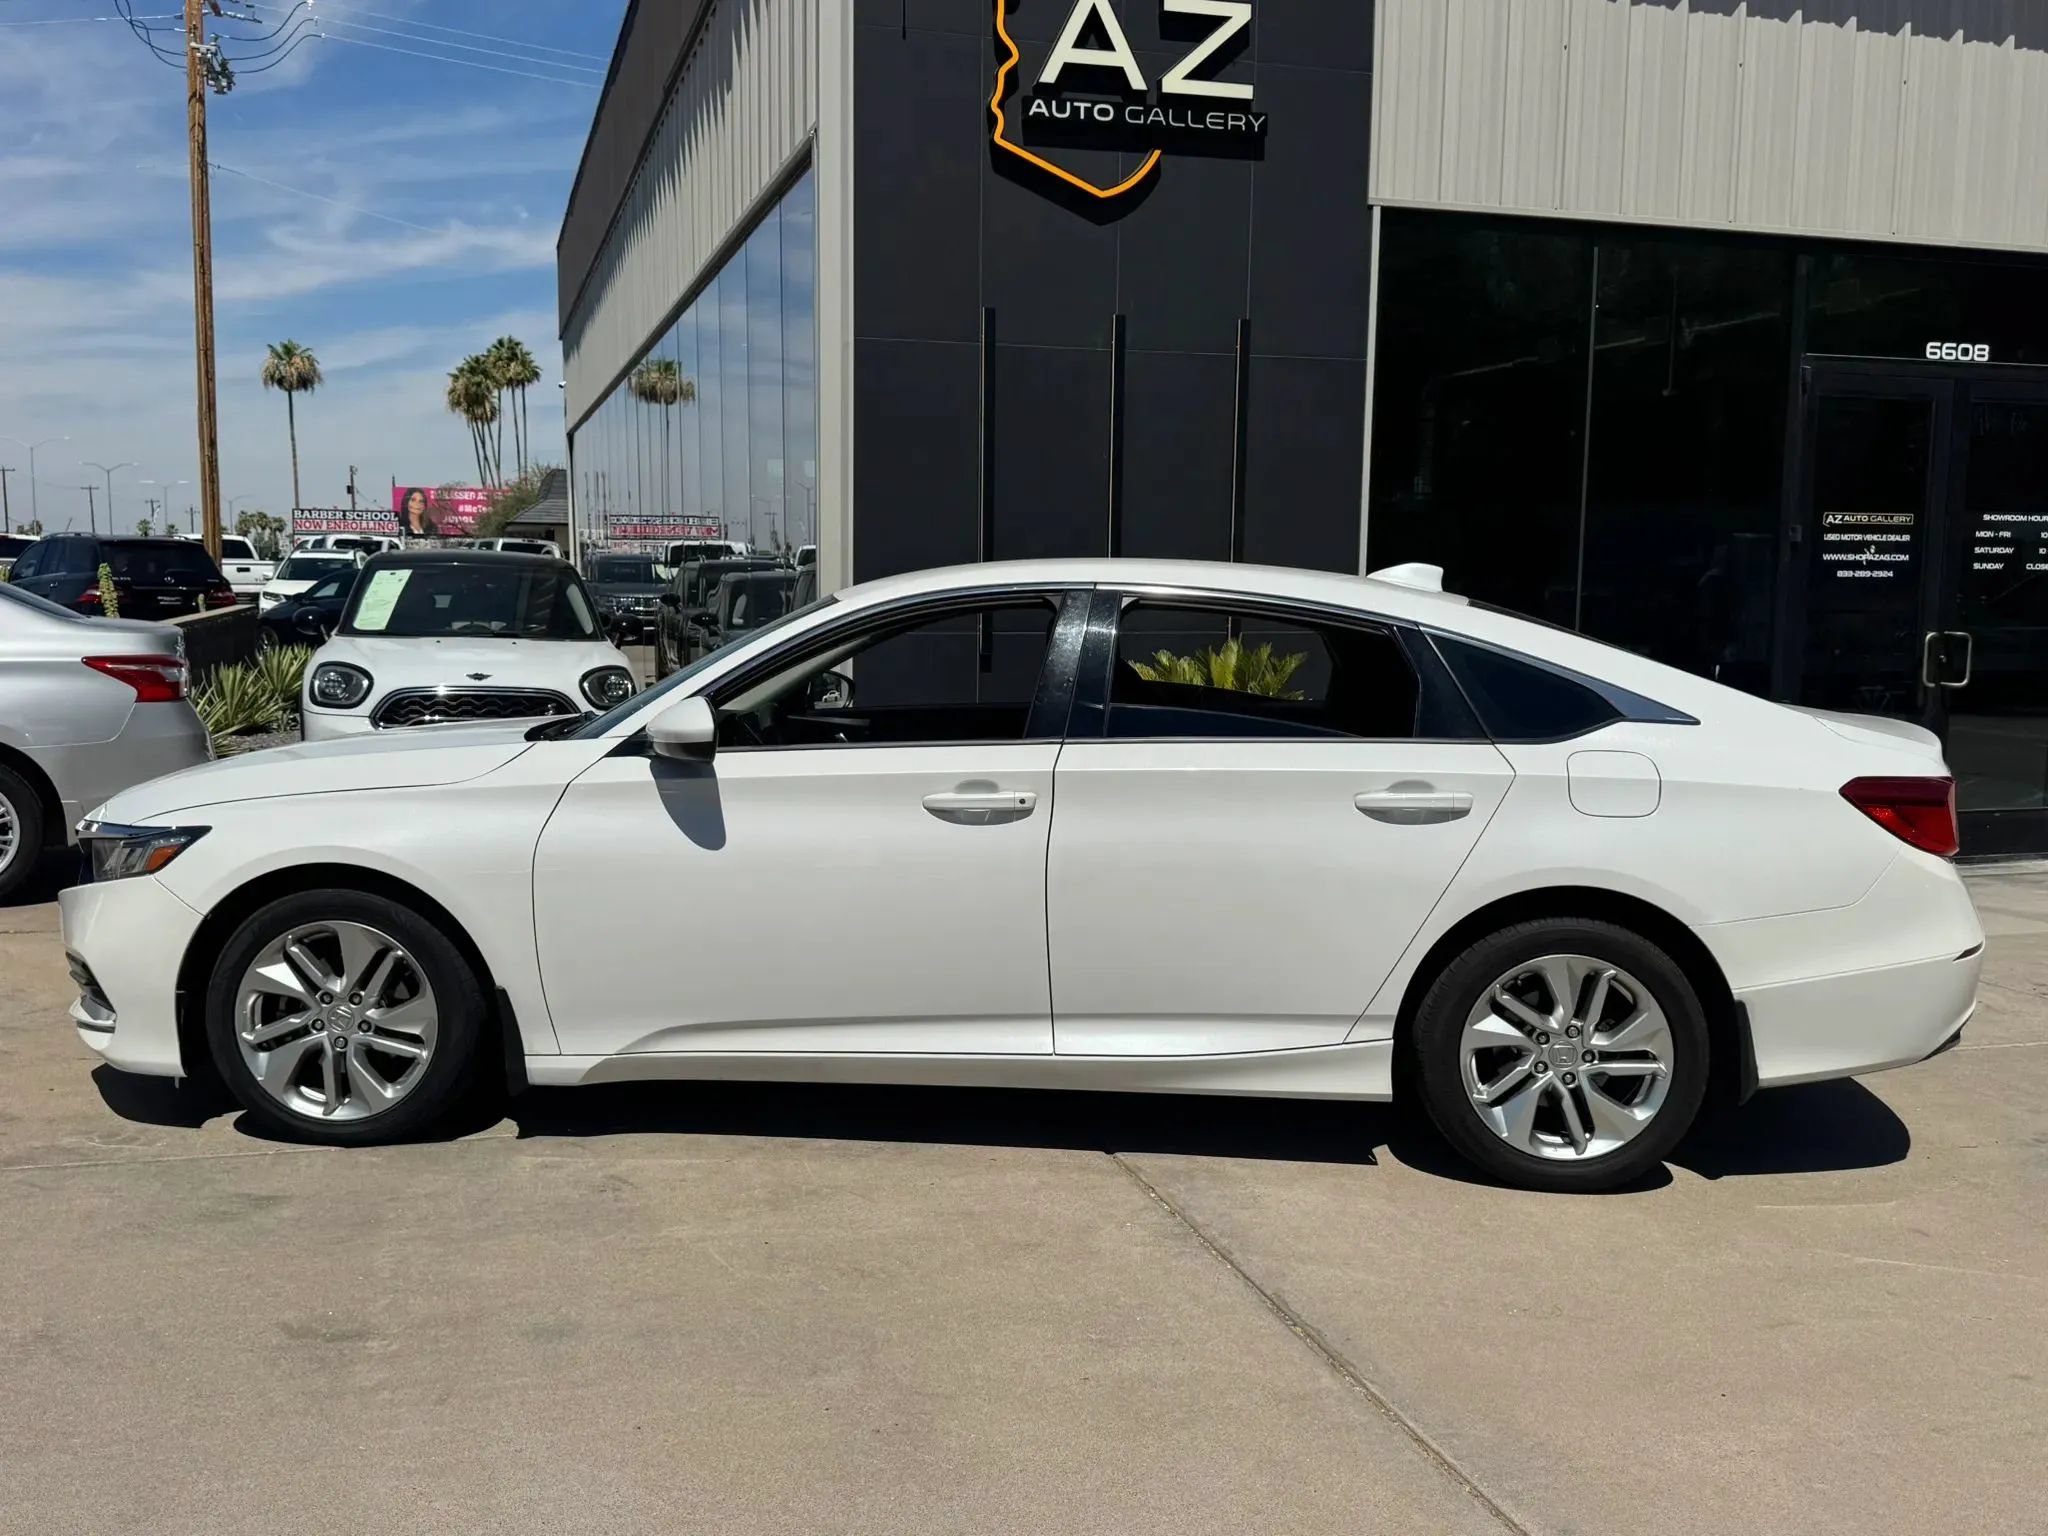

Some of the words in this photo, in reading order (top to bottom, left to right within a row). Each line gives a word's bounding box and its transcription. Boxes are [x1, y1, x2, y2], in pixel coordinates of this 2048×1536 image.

[1038, 0, 1254, 100] AZ
[1028, 99, 1115, 122] AUTO
[1124, 105, 1267, 132] GALLERY
[1925, 341, 1990, 362] 6608
[293, 509, 344, 519] BARBER
[345, 511, 399, 521] SCHOOL
[1826, 514, 1843, 524] AZ
[1843, 514, 1869, 522] AUTO
[1869, 515, 1911, 523] GALLERY
[294, 520, 323, 530] NOW
[1823, 533, 1840, 541] USED
[1840, 533, 1863, 541] MOTOR
[1887, 534, 1911, 542] DEALER
